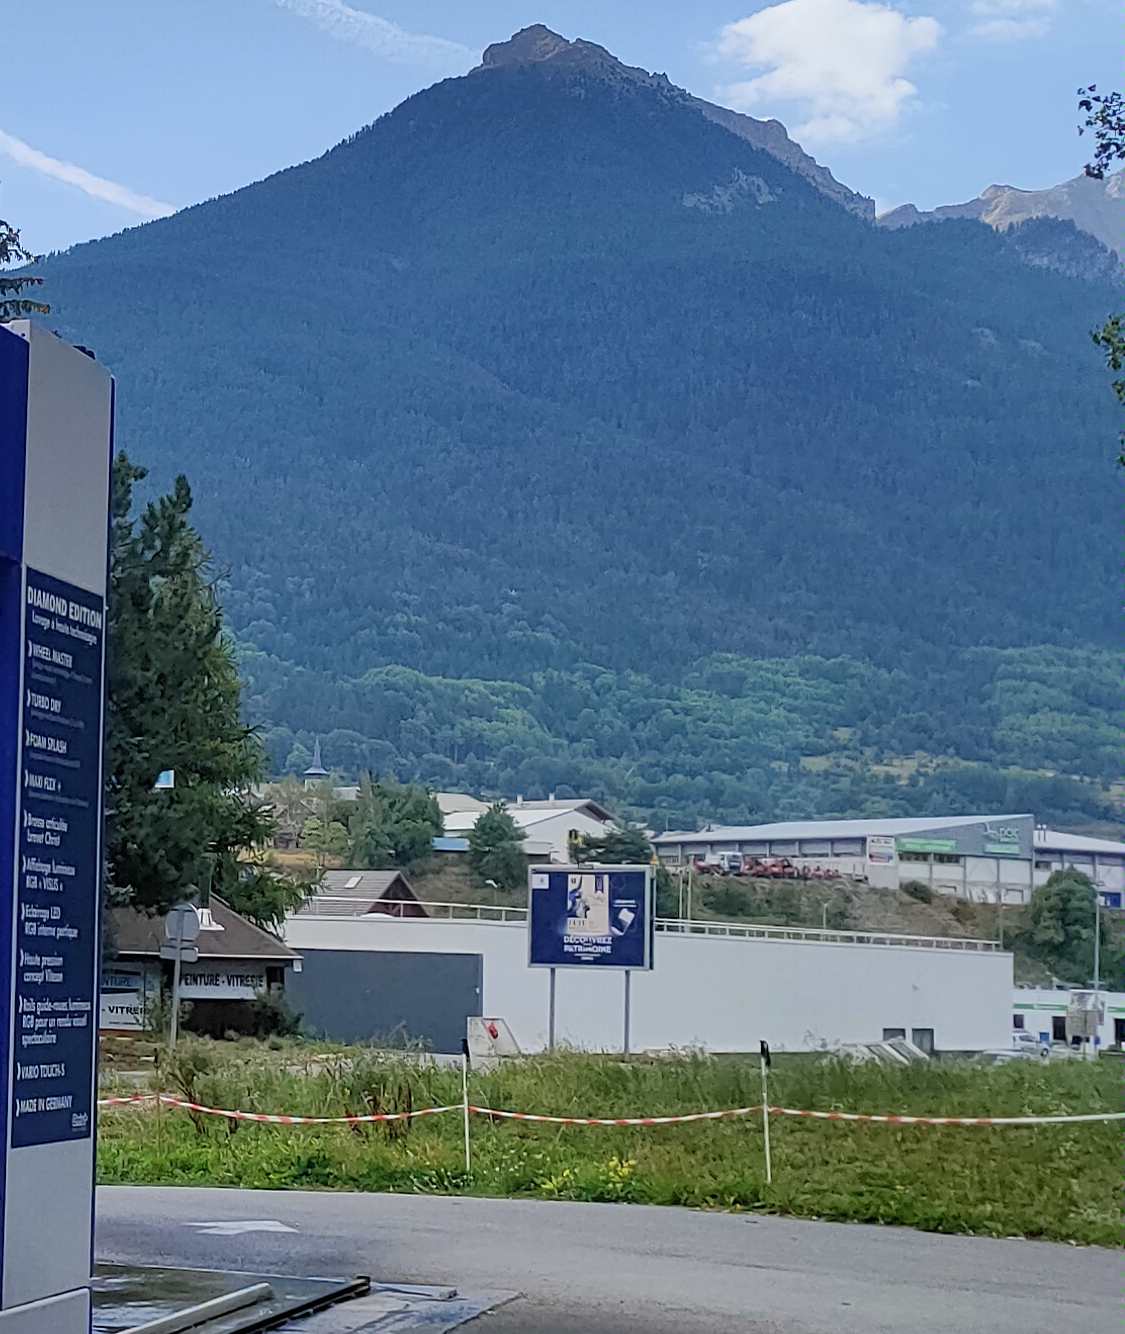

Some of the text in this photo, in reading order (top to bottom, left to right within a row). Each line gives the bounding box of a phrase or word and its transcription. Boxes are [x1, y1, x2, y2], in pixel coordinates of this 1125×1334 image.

[27, 585, 103, 630] DIAMOND EDITION
[32, 642, 73, 669] WHEEL MASTER
[31, 692, 62, 714] TURBO DRY
[30, 733, 67, 754] FOAM SPLASH
[28, 773, 43, 789] MAXI
[43, 777, 57, 792] FLEX
[21, 1065, 40, 1079] VARIO
[20, 1095, 73, 1113] MADE IN GERMANY
